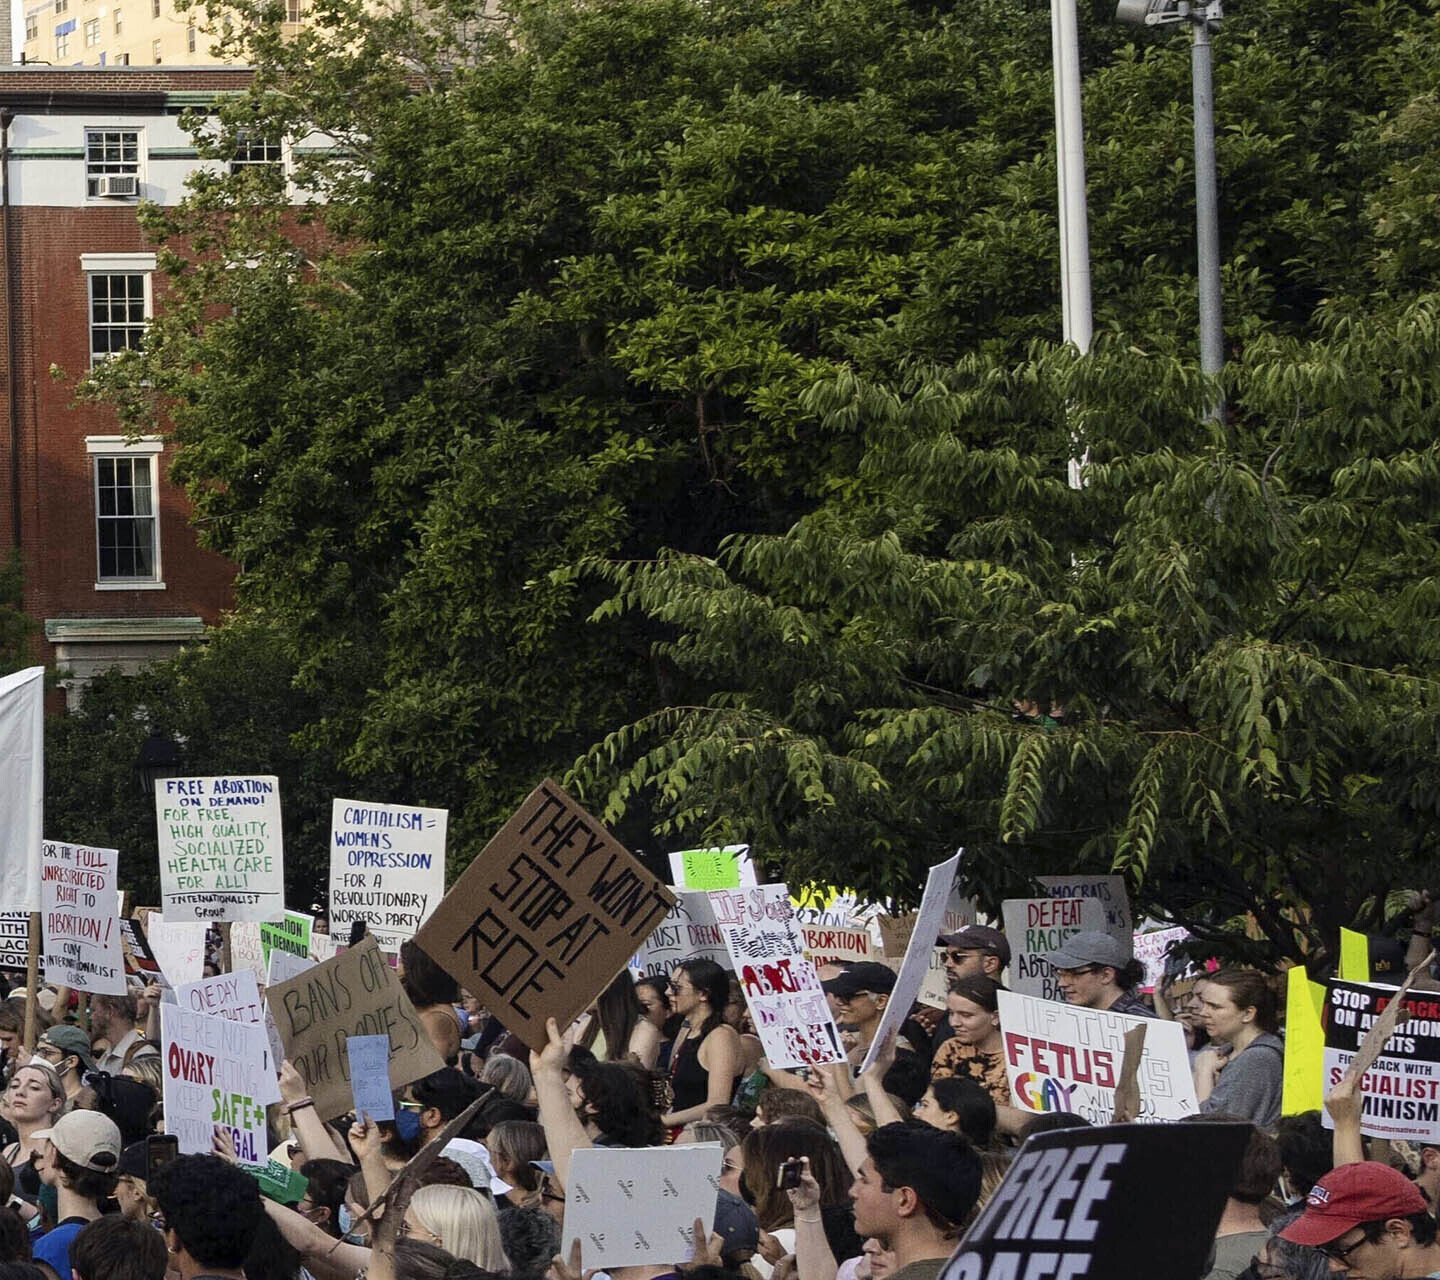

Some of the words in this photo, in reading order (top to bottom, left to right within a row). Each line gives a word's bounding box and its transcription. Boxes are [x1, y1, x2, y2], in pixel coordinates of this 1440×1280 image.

[166, 781, 204, 794] FREE
[213, 780, 272, 794] ABORTION
[180, 798, 200, 806] ON
[209, 796, 264, 806] DEMAND!
[164, 809, 191, 820] FOR
[344, 807, 422, 830] CAPITALISM
[170, 824, 203, 838] HIGH
[520, 786, 605, 877] THEY
[174, 840, 264, 856] SOCIALIZED
[168, 858, 229, 873] HEALTH
[234, 856, 272, 872] CARE
[348, 850, 432, 869] OPPRESSION
[178, 876, 204, 889] FOR
[216, 876, 248, 888] ALL!
[373, 874, 382, 888] A
[170, 894, 260, 904] INTERNATIONALIST
[334, 890, 427, 912] REVOLUTIONARY
[489, 852, 574, 932] STOP
[546, 913, 610, 966] AT
[330, 910, 380, 925] WORKERS
[385, 911, 424, 927] PARTY
[452, 908, 565, 1020] ROE
[969, 1143, 1128, 1241] FREE
